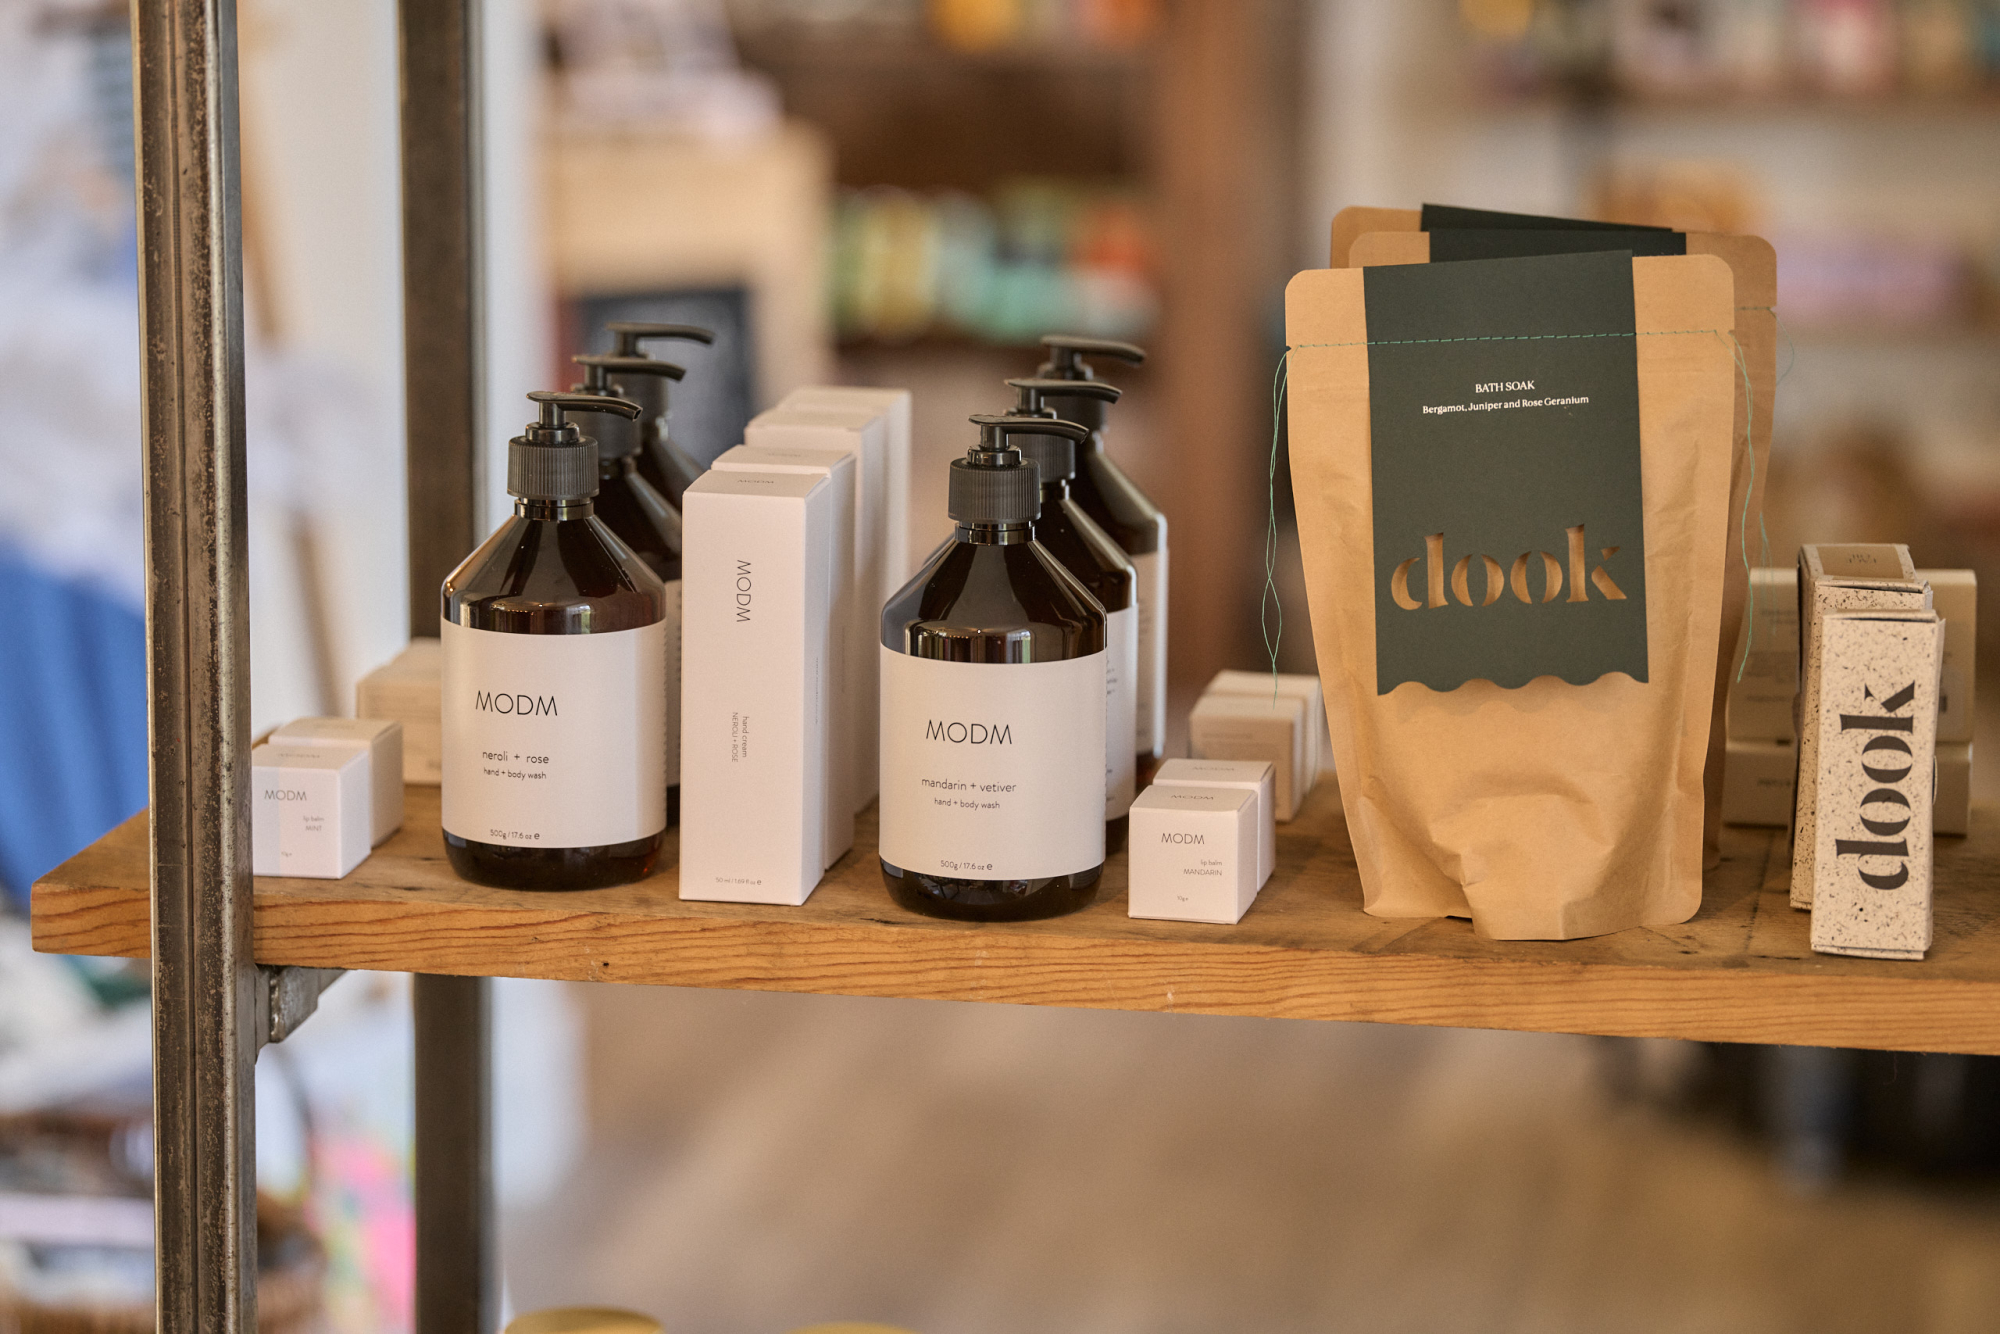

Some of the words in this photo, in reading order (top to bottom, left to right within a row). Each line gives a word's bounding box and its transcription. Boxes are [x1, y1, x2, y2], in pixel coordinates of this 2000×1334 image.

[1475, 382, 1504, 393] BATH
[1505, 380, 1535, 391] SOAK
[1422, 404, 1468, 415] Bergamot,
[1468, 401, 1503, 412] Juniper
[1503, 399, 1521, 409] and
[1522, 398, 1543, 408] Rose
[1544, 395, 1590, 406] Geranium
[1391, 523, 1628, 611] dook
[736, 559, 752, 622] MODM
[475, 690, 558, 717] MODM
[742, 716, 750, 734] hand
[926, 719, 1013, 745] MODM
[482, 750, 508, 762] neroli
[514, 753, 520, 761] +
[526, 755, 549, 764] rose
[731, 744, 739, 763] ROSE
[483, 767, 500, 777] hand
[507, 769, 526, 781] body
[527, 771, 547, 780] wash
[921, 778, 967, 792] mandarin
[970, 782, 977, 790] +
[979, 781, 1017, 793] vetiver
[1836, 680, 1916, 891] dook
[264, 789, 307, 801] MODM
[934, 797, 952, 807] hand
[960, 800, 979, 811] body
[981, 801, 1000, 810] wash
[490, 829, 507, 840] 500g
[511, 831, 524, 840] 17.6
[1161, 832, 1205, 845] MODM
[940, 860, 959, 871] 500g
[963, 862, 977, 870] 17.6
[1200, 859, 1208, 867] lip
[1183, 868, 1223, 877] MANDARIN
